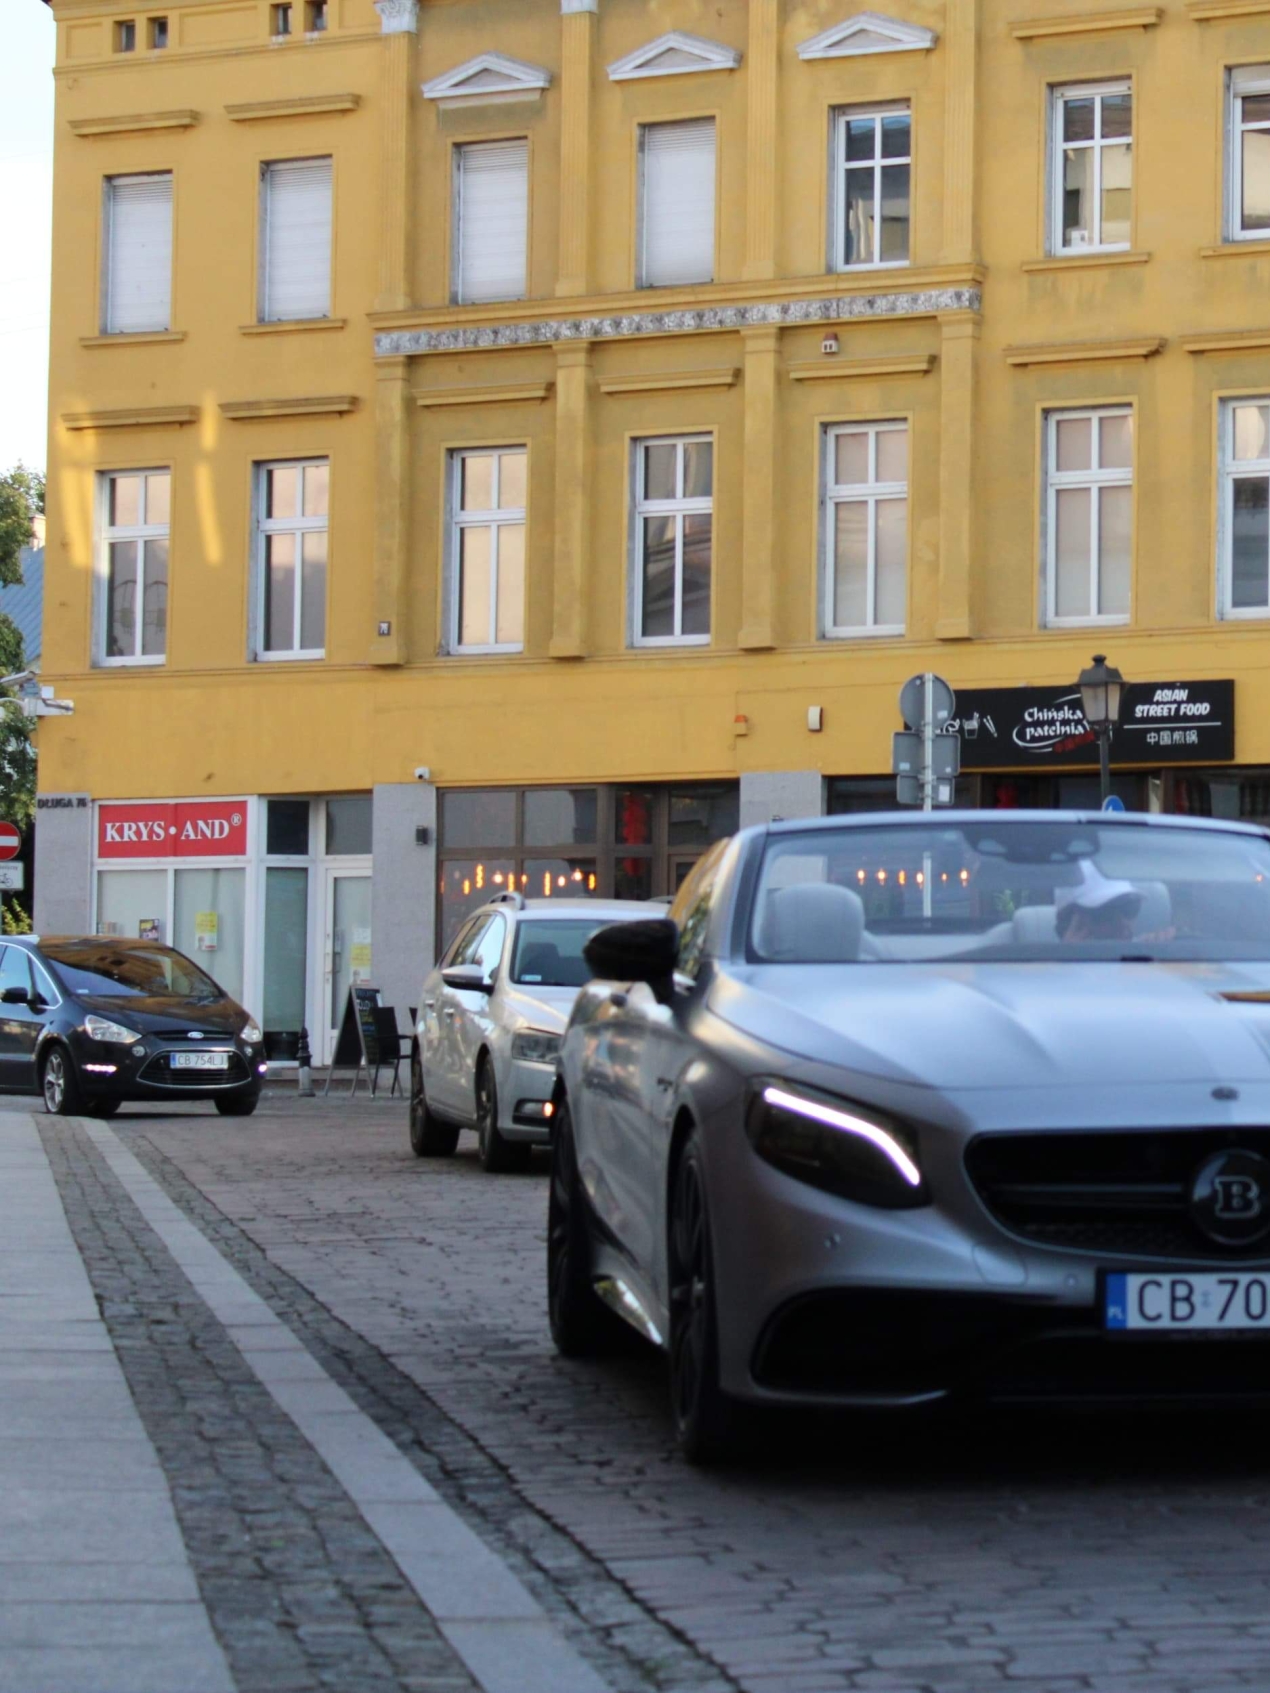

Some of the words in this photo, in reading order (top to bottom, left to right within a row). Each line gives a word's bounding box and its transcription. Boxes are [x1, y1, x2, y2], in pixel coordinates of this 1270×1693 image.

[1153, 688, 1189, 703] ASIAN
[1024, 705, 1084, 722] Chińska
[1134, 703, 1178, 718] STREET
[1180, 702, 1211, 716] FOOD
[1025, 720, 1085, 741] patelnia
[104, 821, 165, 842] KRYS
[177, 1055, 192, 1066] CB
[1137, 1278, 1196, 1323] CB
